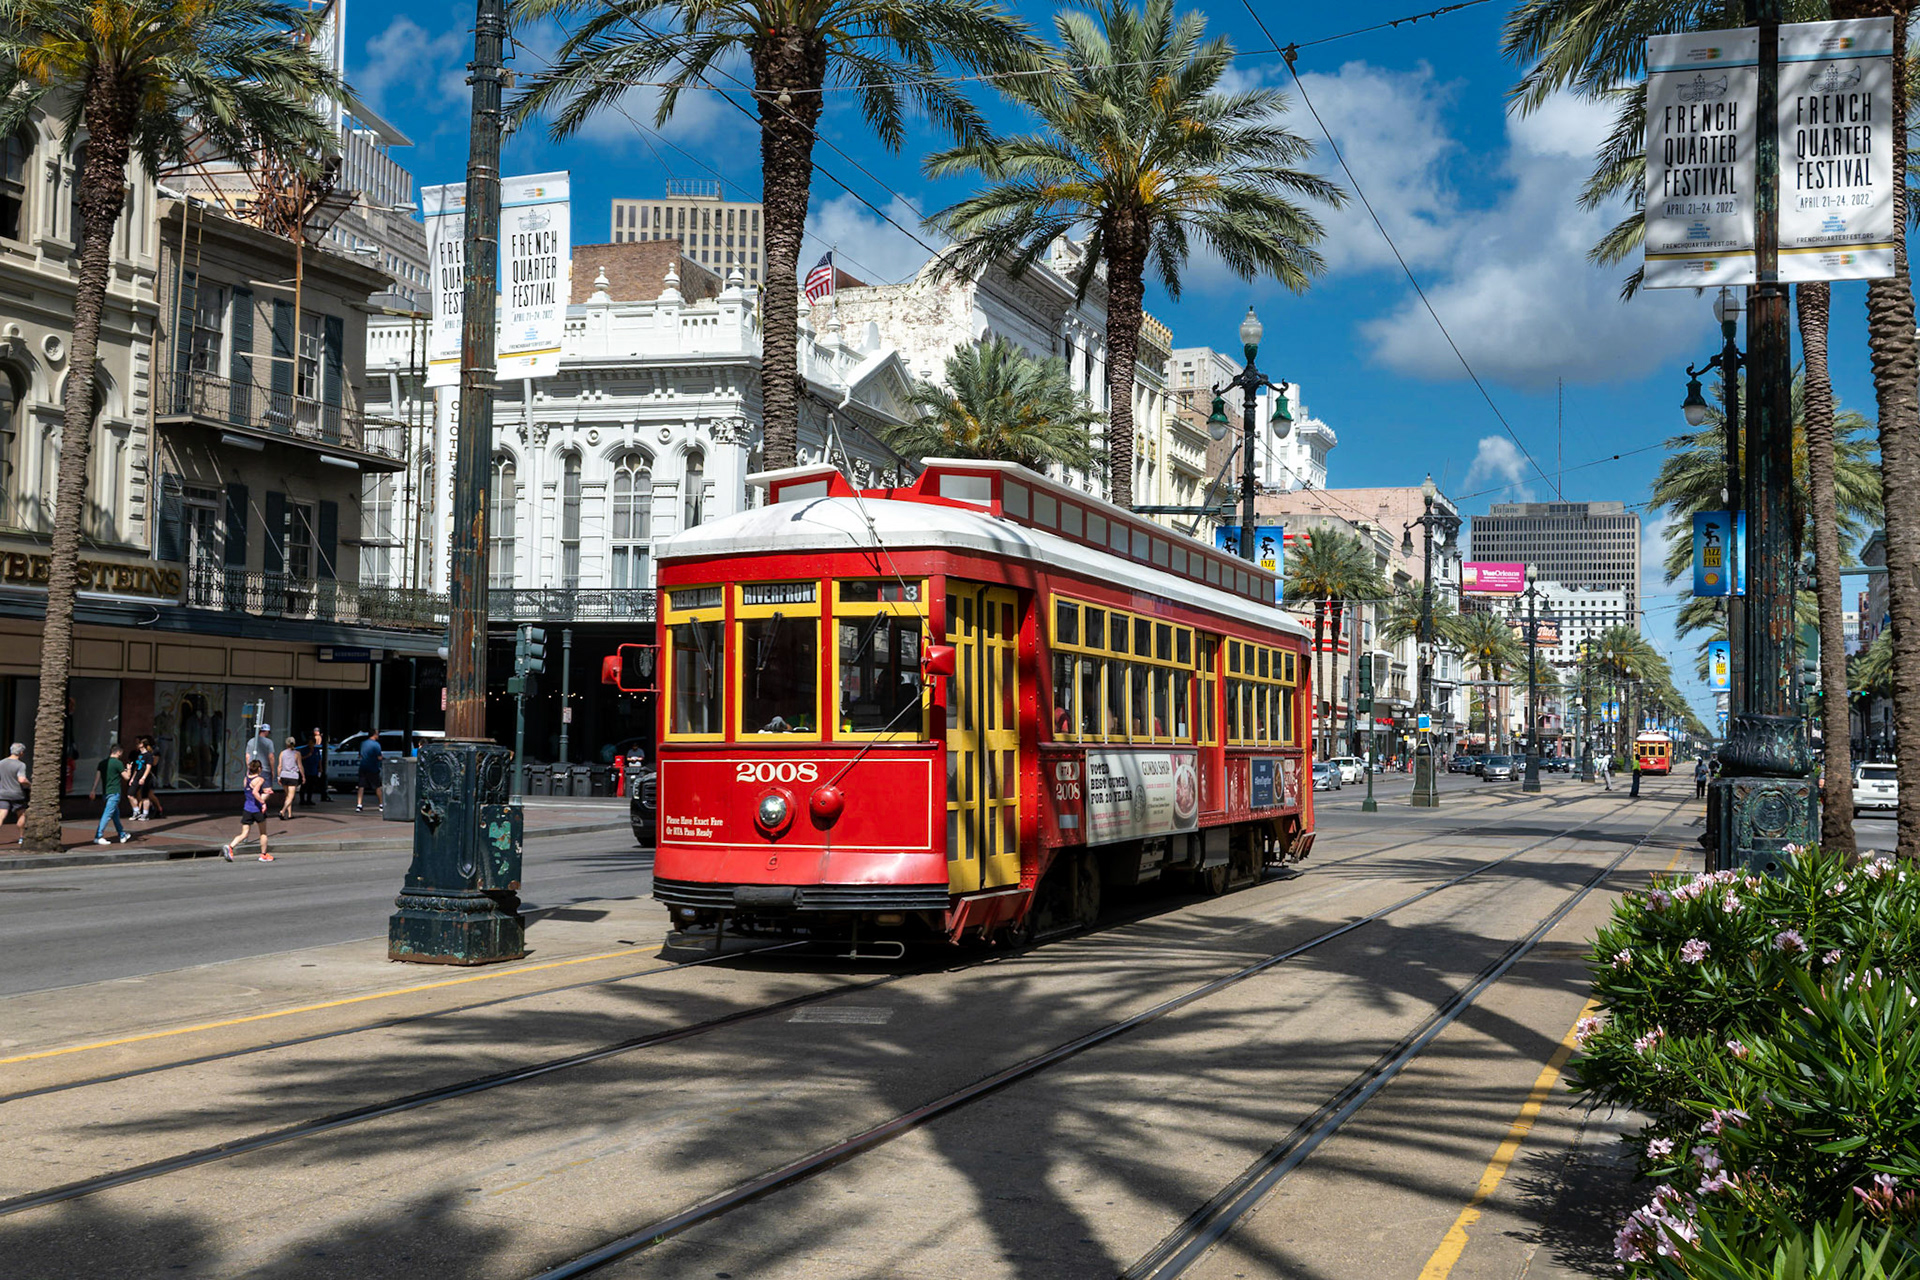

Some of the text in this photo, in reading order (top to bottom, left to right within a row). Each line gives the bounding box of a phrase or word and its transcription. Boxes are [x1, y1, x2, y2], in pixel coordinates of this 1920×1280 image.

[1665, 102, 1737, 134] FRENCH
[1797, 93, 1872, 125] FRENCH
[1797, 125, 1872, 159] QUARTER
[1665, 135, 1737, 168] QUARTER
[1664, 166, 1737, 197] FESTIVAL
[1797, 158, 1872, 190] FESTIVAL
[1667, 204, 1685, 215] APRIL
[1716, 202, 1734, 213] 2022
[1800, 197, 1819, 208] APRIL
[1851, 193, 1870, 205] 2022
[512, 231, 557, 257] FRENCH
[1663, 241, 1737, 250] FRENCHQUARTERFEST.ORG
[1796, 233, 1874, 243] FRENCHQUARTERFEST.ORG
[440, 241, 463, 265] FRE
[512, 257, 557, 284] QUARTER
[443, 292, 464, 315] FEST
[512, 282, 556, 308] FESTIVAL
[514, 312, 524, 322] APRIL
[1493, 506, 1520, 514] Tulane
[0, 552, 182, 596] BESTEINS
[673, 588, 722, 608] FRENCH MARKE
[744, 583, 816, 605] RIVERFRONT
[905, 585, 918, 601] 3
[332, 759, 361, 767] POLIC
[736, 762, 818, 782] 2008
[1090, 763, 1109, 775] VOTED
[1142, 761, 1157, 775] GUMBO
[1056, 783, 1080, 800] 2008
[1091, 777, 1129, 790] BEST GUMBO
[1091, 790, 1132, 804] FOR 20 YEARS
[666, 815, 723, 826] Please Have Exact Fare
[666, 826, 713, 838] Or RTA Pass Ready
